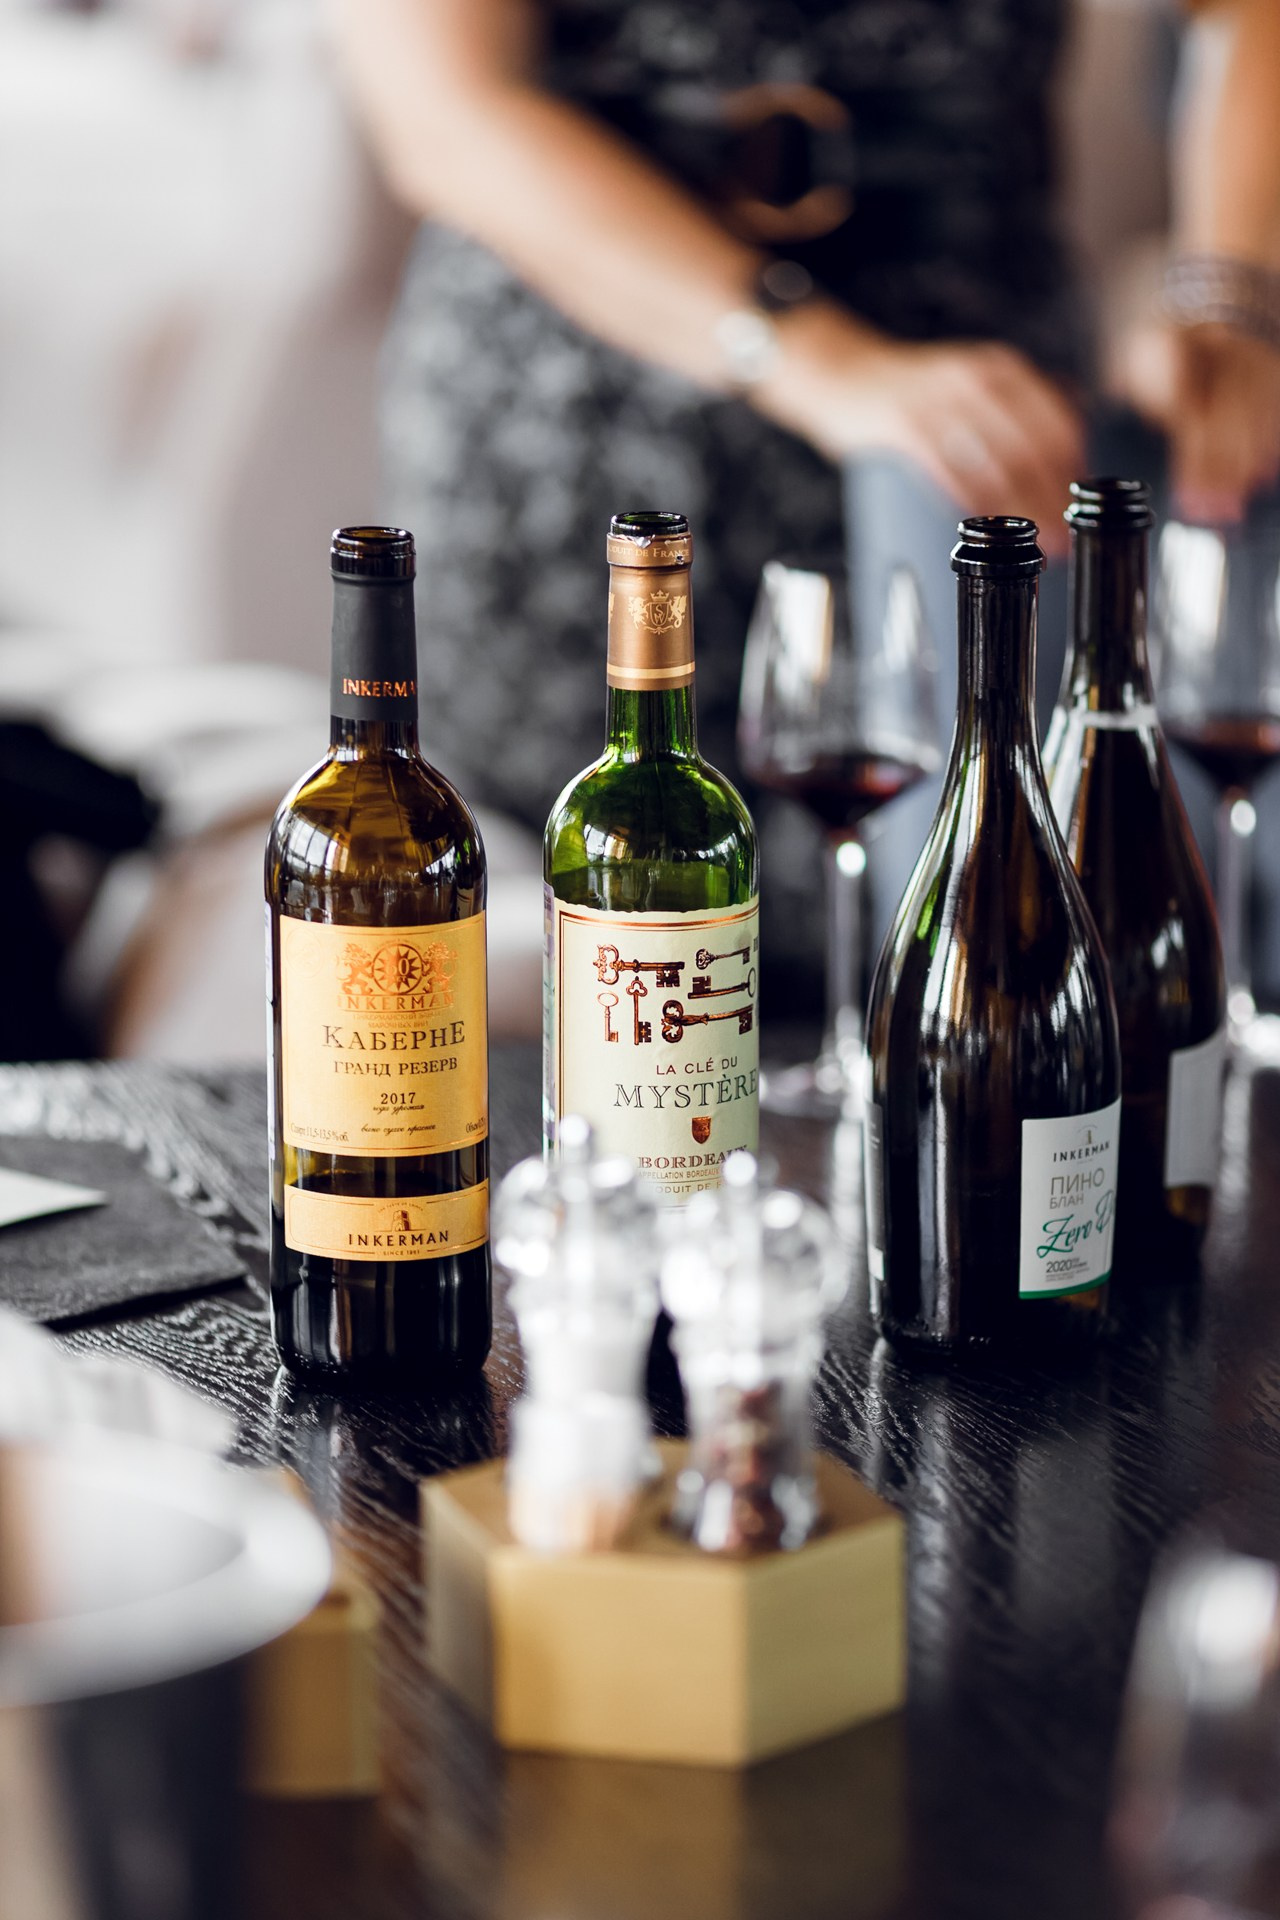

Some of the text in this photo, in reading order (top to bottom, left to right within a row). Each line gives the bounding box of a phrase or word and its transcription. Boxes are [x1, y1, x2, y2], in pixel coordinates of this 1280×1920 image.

[635, 549, 649, 557] DE
[342, 678, 416, 698] INKERMA
[336, 991, 454, 1011] INKERMAN
[321, 1021, 466, 1051] КАБЕРНЕ
[334, 1057, 458, 1078] ГРАНД РЕЗЕРВ
[656, 1055, 738, 1076] LA CLÉ DU
[380, 1092, 416, 1105] 2017
[613, 1069, 758, 1109] MYSTÈRE
[637, 1145, 748, 1169] BORDEA
[1053, 1141, 1110, 1163] INKERMAN
[638, 1170, 684, 1180] APPELLATION
[1050, 1167, 1105, 1196] ПИНО
[654, 1183, 692, 1195] ODUIT
[697, 1182, 712, 1192] DE
[1049, 1193, 1085, 1210] БЛАН
[348, 1230, 450, 1247] INKERMAN
[1036, 1213, 1093, 1259] Zero
[1046, 1259, 1073, 1273] 2020
